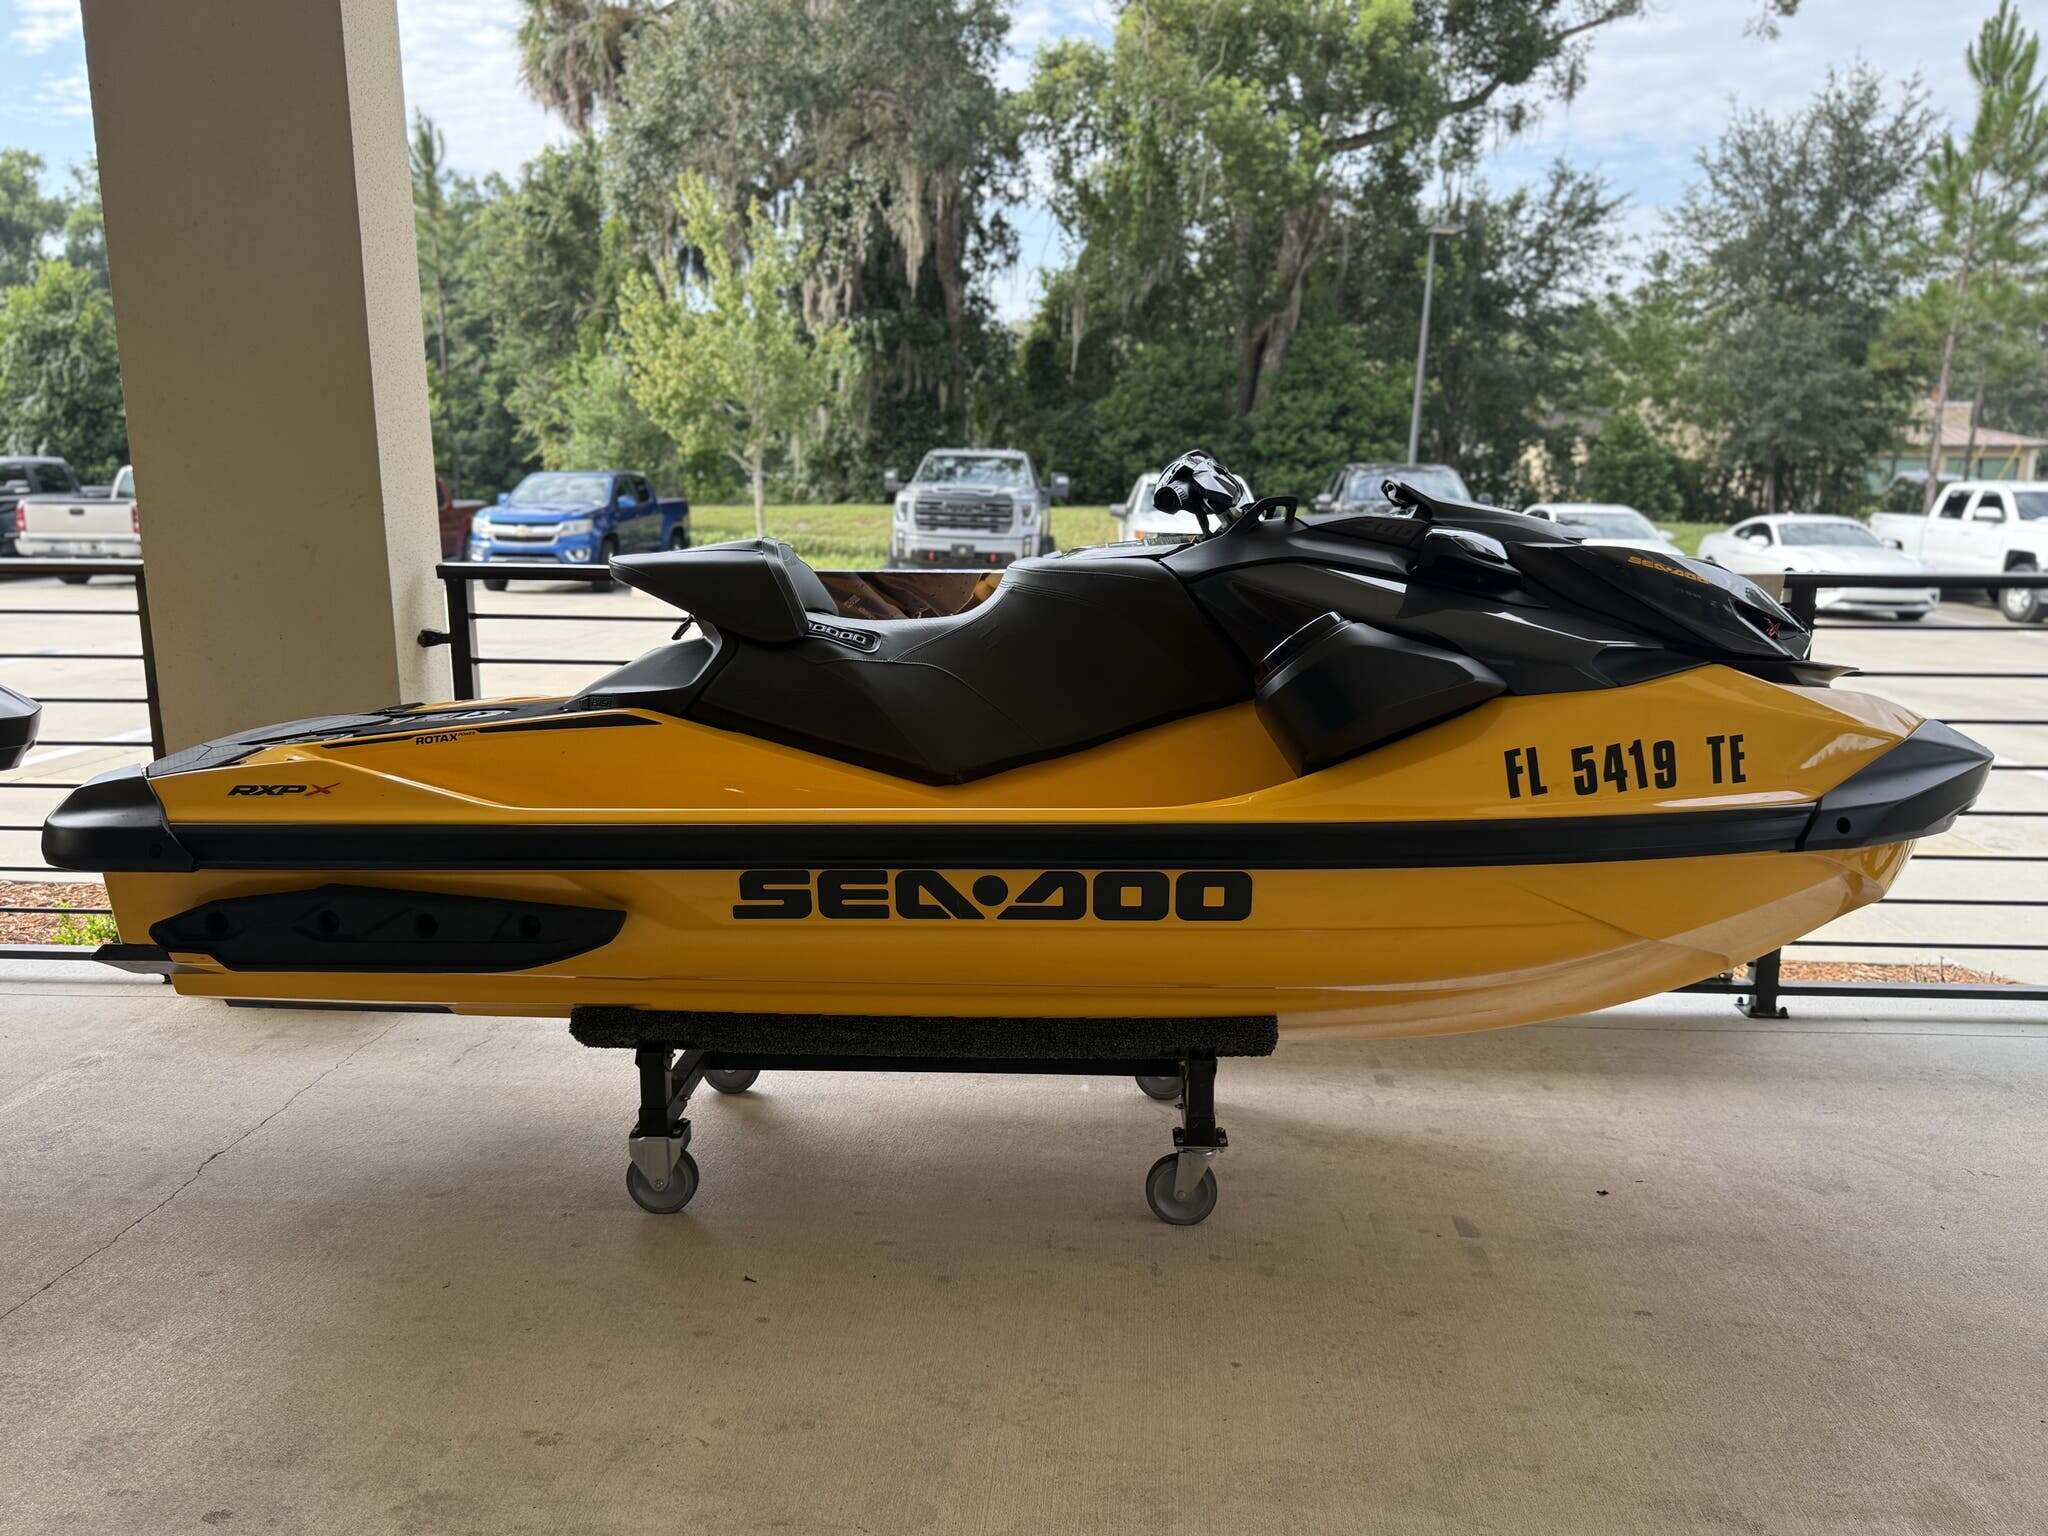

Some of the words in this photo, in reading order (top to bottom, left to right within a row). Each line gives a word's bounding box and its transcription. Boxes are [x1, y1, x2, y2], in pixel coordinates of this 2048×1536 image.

[416, 733, 458, 746] ROTAX
[1503, 746, 1548, 799] FL
[1570, 738, 1677, 797] 5419
[1706, 734, 1747, 784] TE
